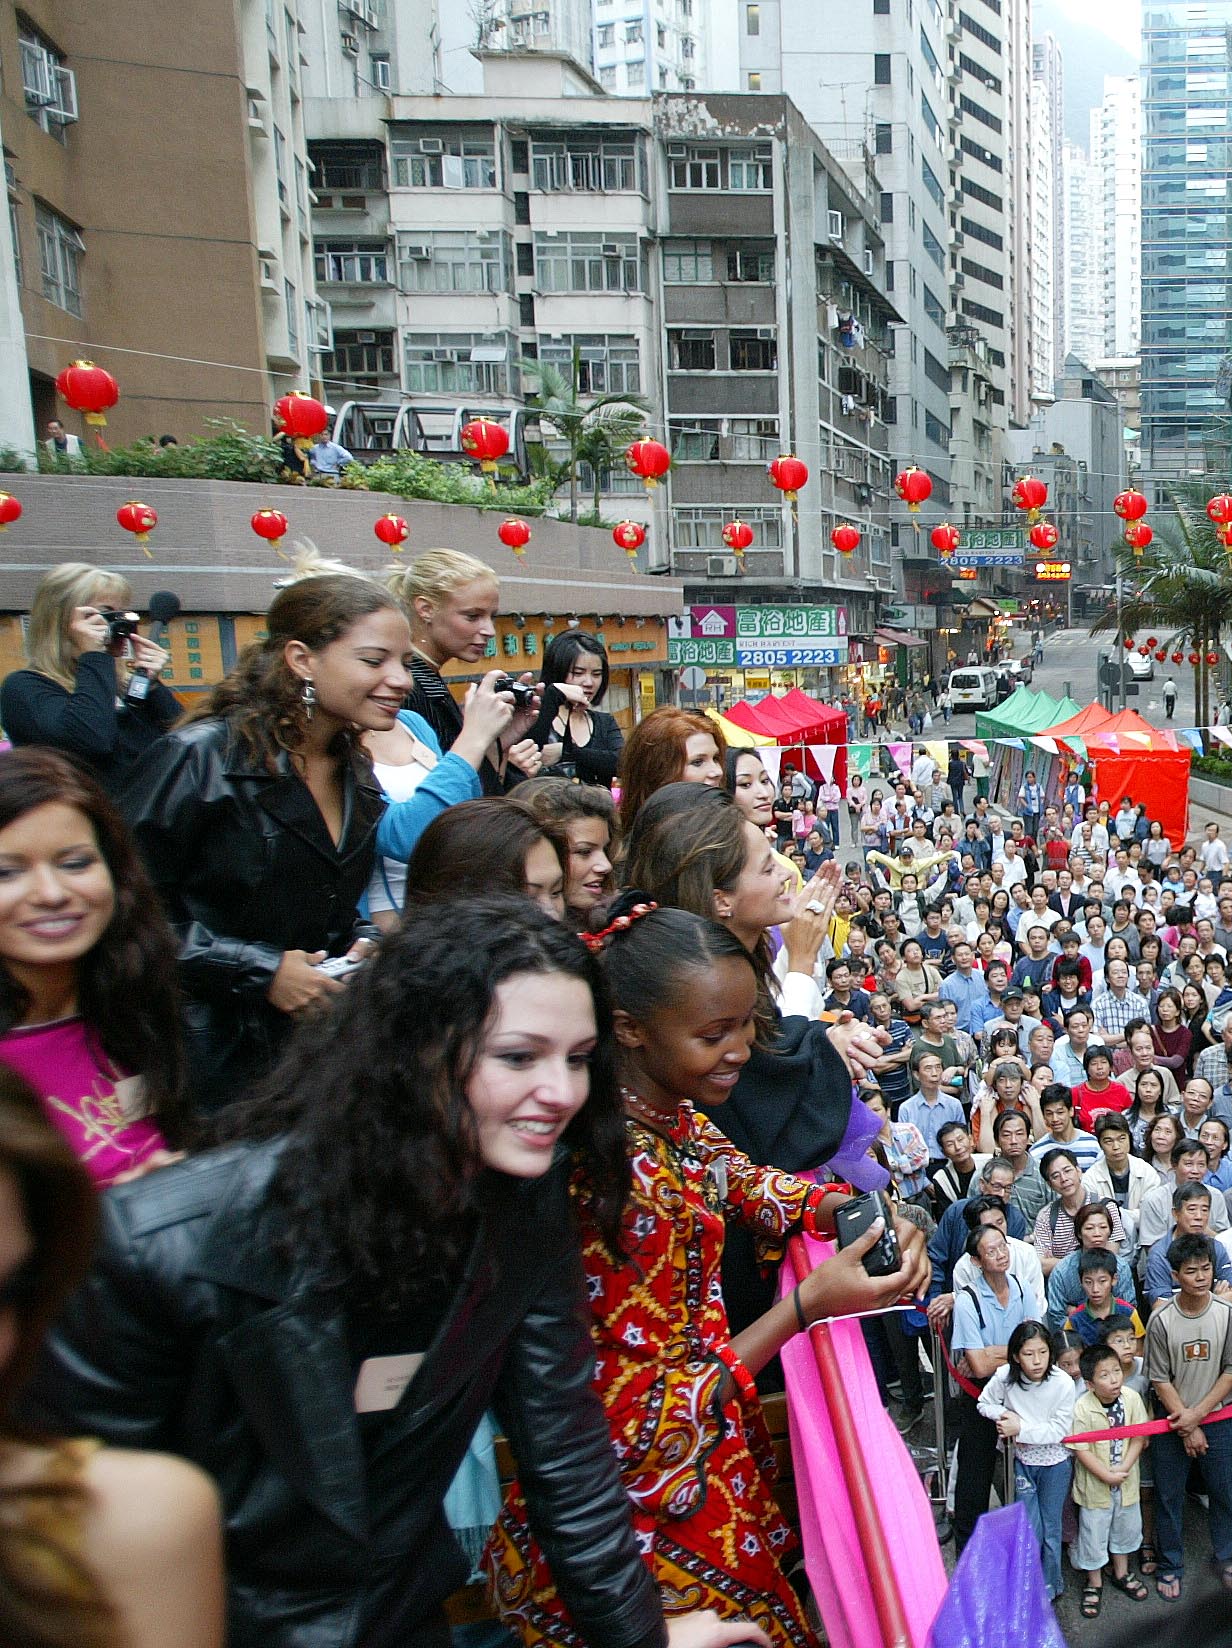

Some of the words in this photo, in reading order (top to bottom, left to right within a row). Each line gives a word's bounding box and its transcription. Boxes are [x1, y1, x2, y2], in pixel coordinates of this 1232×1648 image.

[939, 557, 978, 566] 2805
[985, 556, 1023, 565] 2223
[704, 623, 722, 632] RH
[738, 608, 831, 636] 富裕地產
[669, 641, 734, 664] 富裕地產
[741, 651, 787, 665] 2805
[791, 650, 835, 664] 2223
